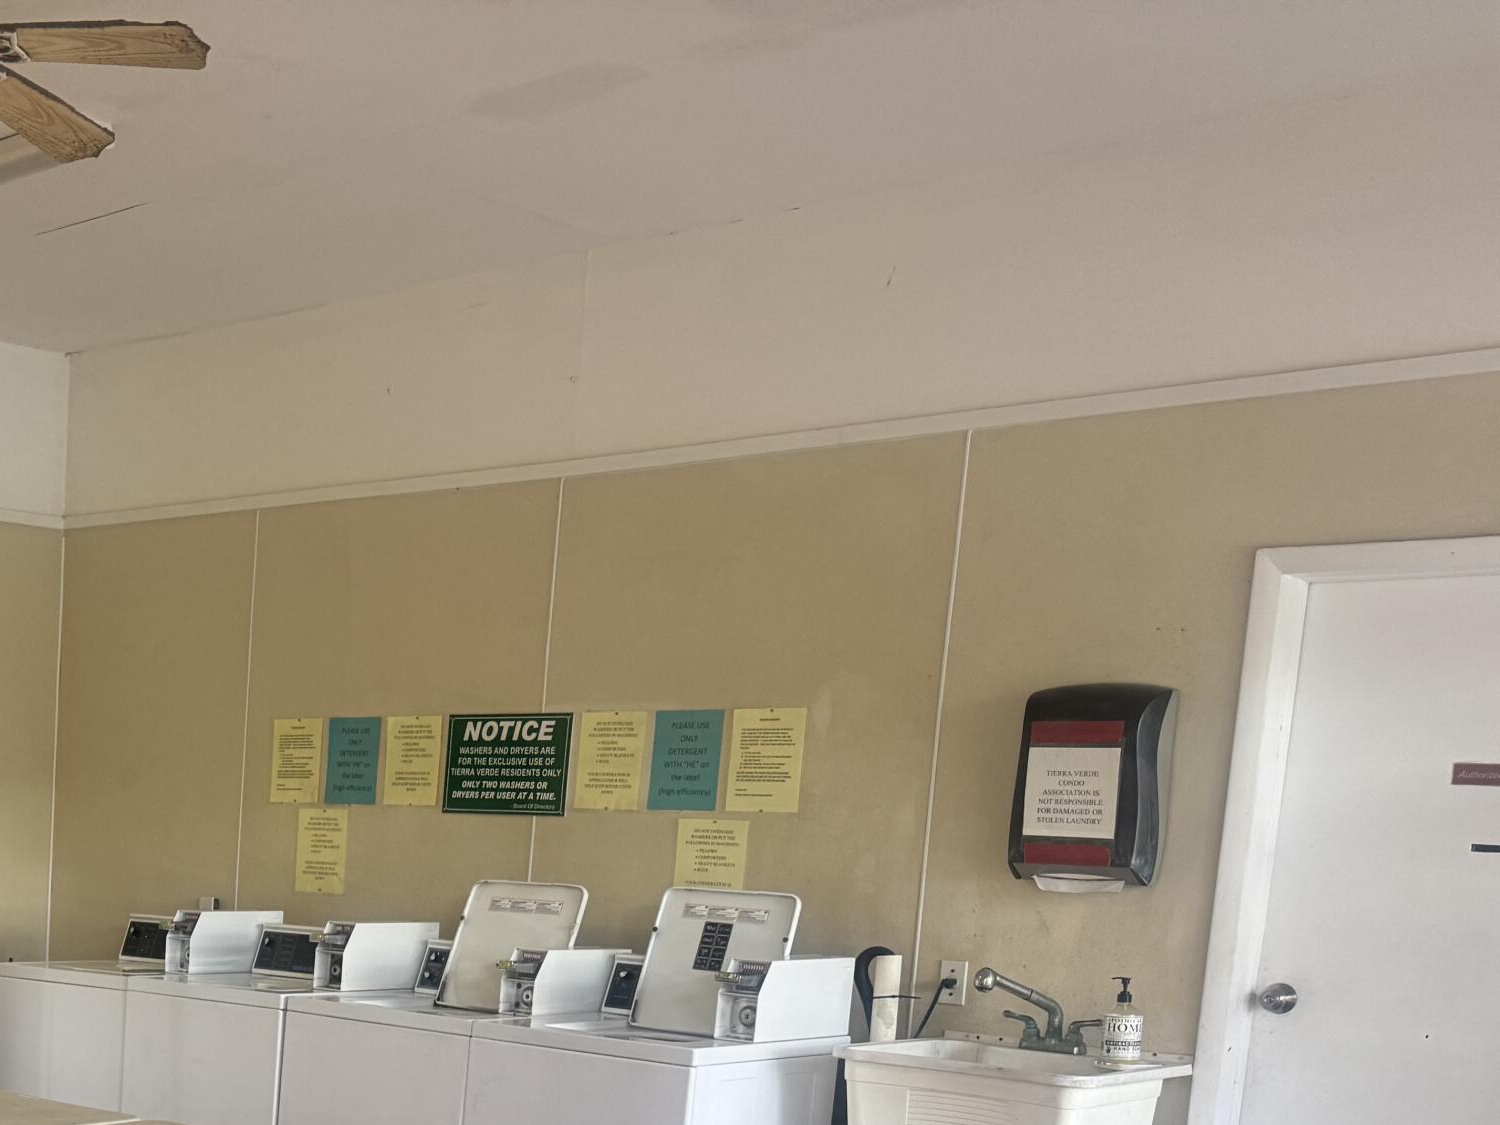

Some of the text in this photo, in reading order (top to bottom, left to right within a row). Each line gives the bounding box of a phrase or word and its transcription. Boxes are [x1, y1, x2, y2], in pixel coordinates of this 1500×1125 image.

[671, 721, 695, 730] PLEASE
[463, 720, 557, 741] NOTICE
[680, 735, 698, 743] ONLY
[459, 747, 556, 755] WASHERS AND DRYERS ARE
[668, 747, 708, 756] DETERGENT
[457, 758, 556, 766] FOR THE EXCLUSIVE USE OF
[451, 768, 562, 777] TIERRA VERDE RESIDENTS ONLY
[1046, 770, 1099, 778] TIERRA VERDE
[461, 780, 480, 788] ONLY
[498, 781, 535, 789] WASHERS
[536, 781, 548, 789] OR
[1058, 779, 1085, 787] CONDO
[451, 791, 557, 801] DRYERS PER USER AT A TIME.
[1053, 807, 1091, 815] DAMAGED
[1037, 816, 1064, 824] STOLEN
